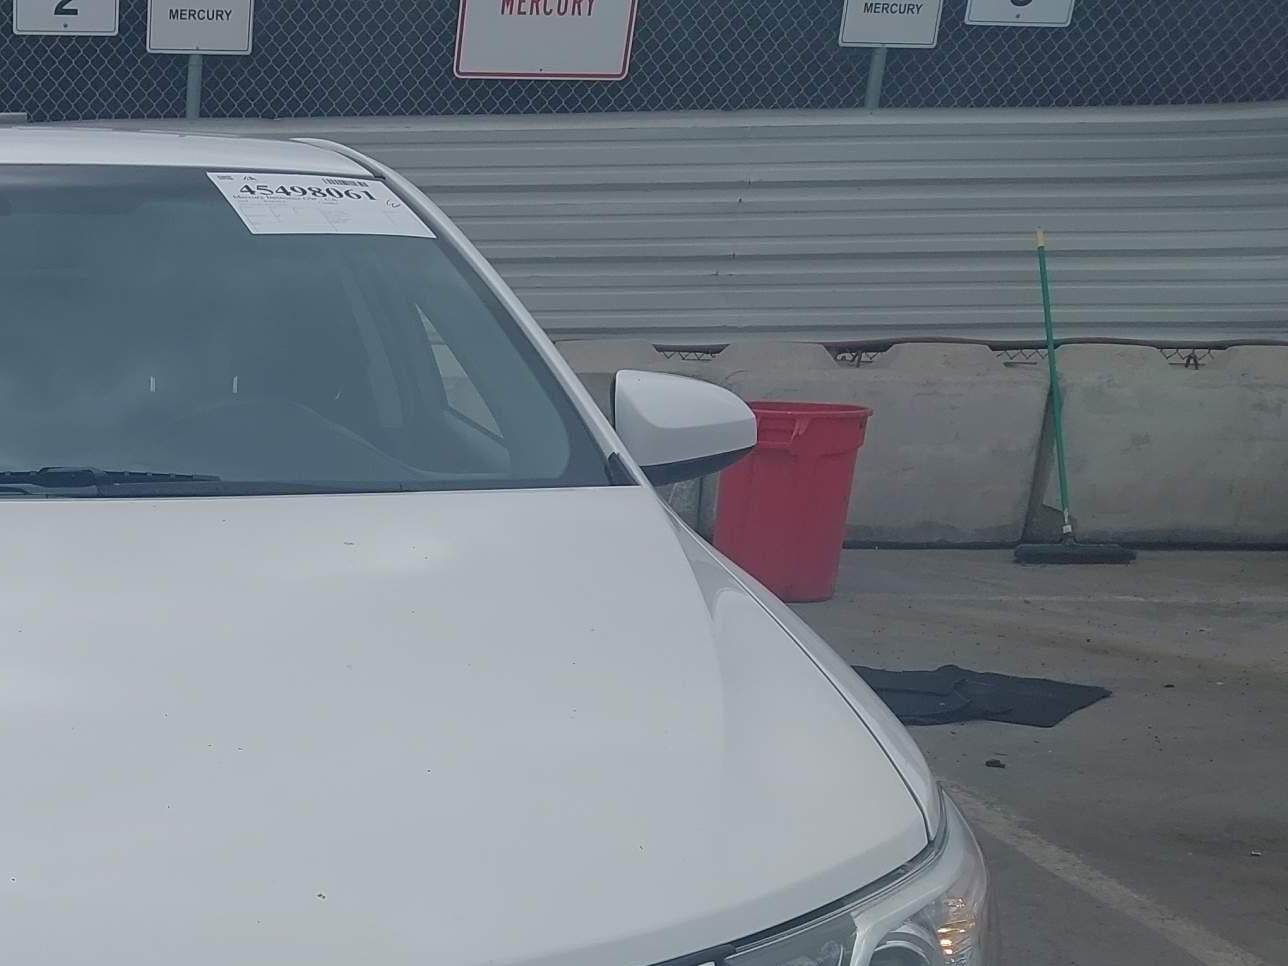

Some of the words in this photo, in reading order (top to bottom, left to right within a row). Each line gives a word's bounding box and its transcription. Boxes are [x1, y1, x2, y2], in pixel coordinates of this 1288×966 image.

[168, 8, 232, 21] MERCURY
[500, 0, 595, 16] MERCURY
[863, 3, 923, 15] MERCURY
[239, 184, 376, 200] 45498061
